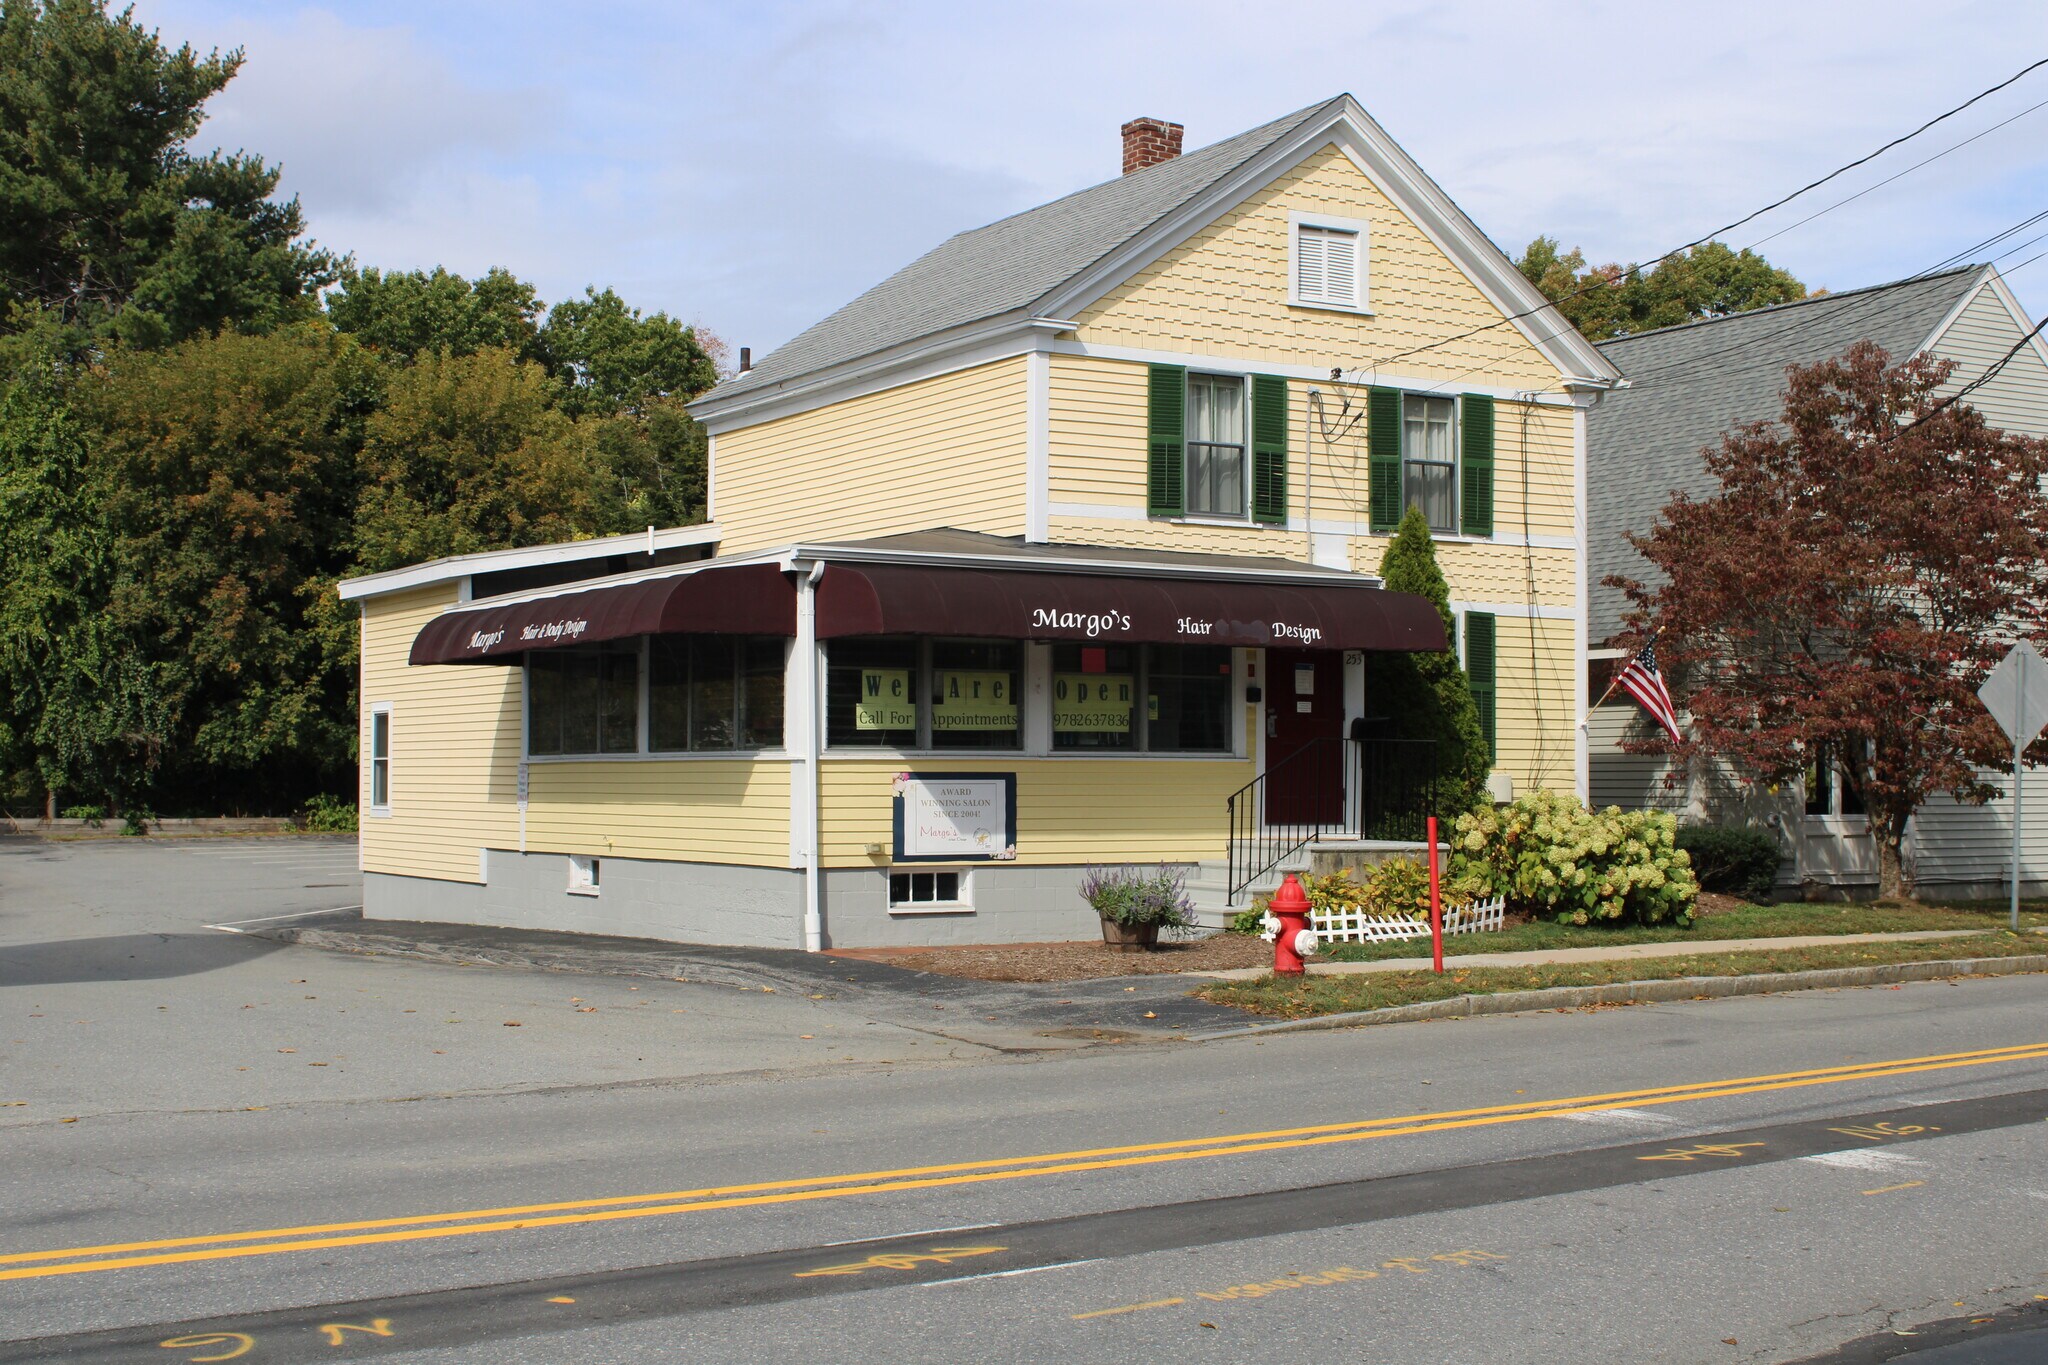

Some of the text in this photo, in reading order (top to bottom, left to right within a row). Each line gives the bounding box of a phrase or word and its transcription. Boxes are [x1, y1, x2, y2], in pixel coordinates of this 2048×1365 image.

[1032, 608, 1322, 644] Margo's Hair Design
[467, 624, 504, 653] Margo's
[520, 624, 540, 640] Hair
[562, 617, 587, 639] Design
[1346, 653, 1362, 665] 253
[865, 675, 1129, 703] We Are Open
[859, 711, 884, 725] Call
[890, 711, 912, 725] For
[932, 712, 1018, 727] Appointments
[940, 788, 971, 796] AWARD
[920, 799, 991, 807] WINNING SALON
[933, 810, 981, 818] SINCE 2004!
[920, 826, 958, 839] Margo's
